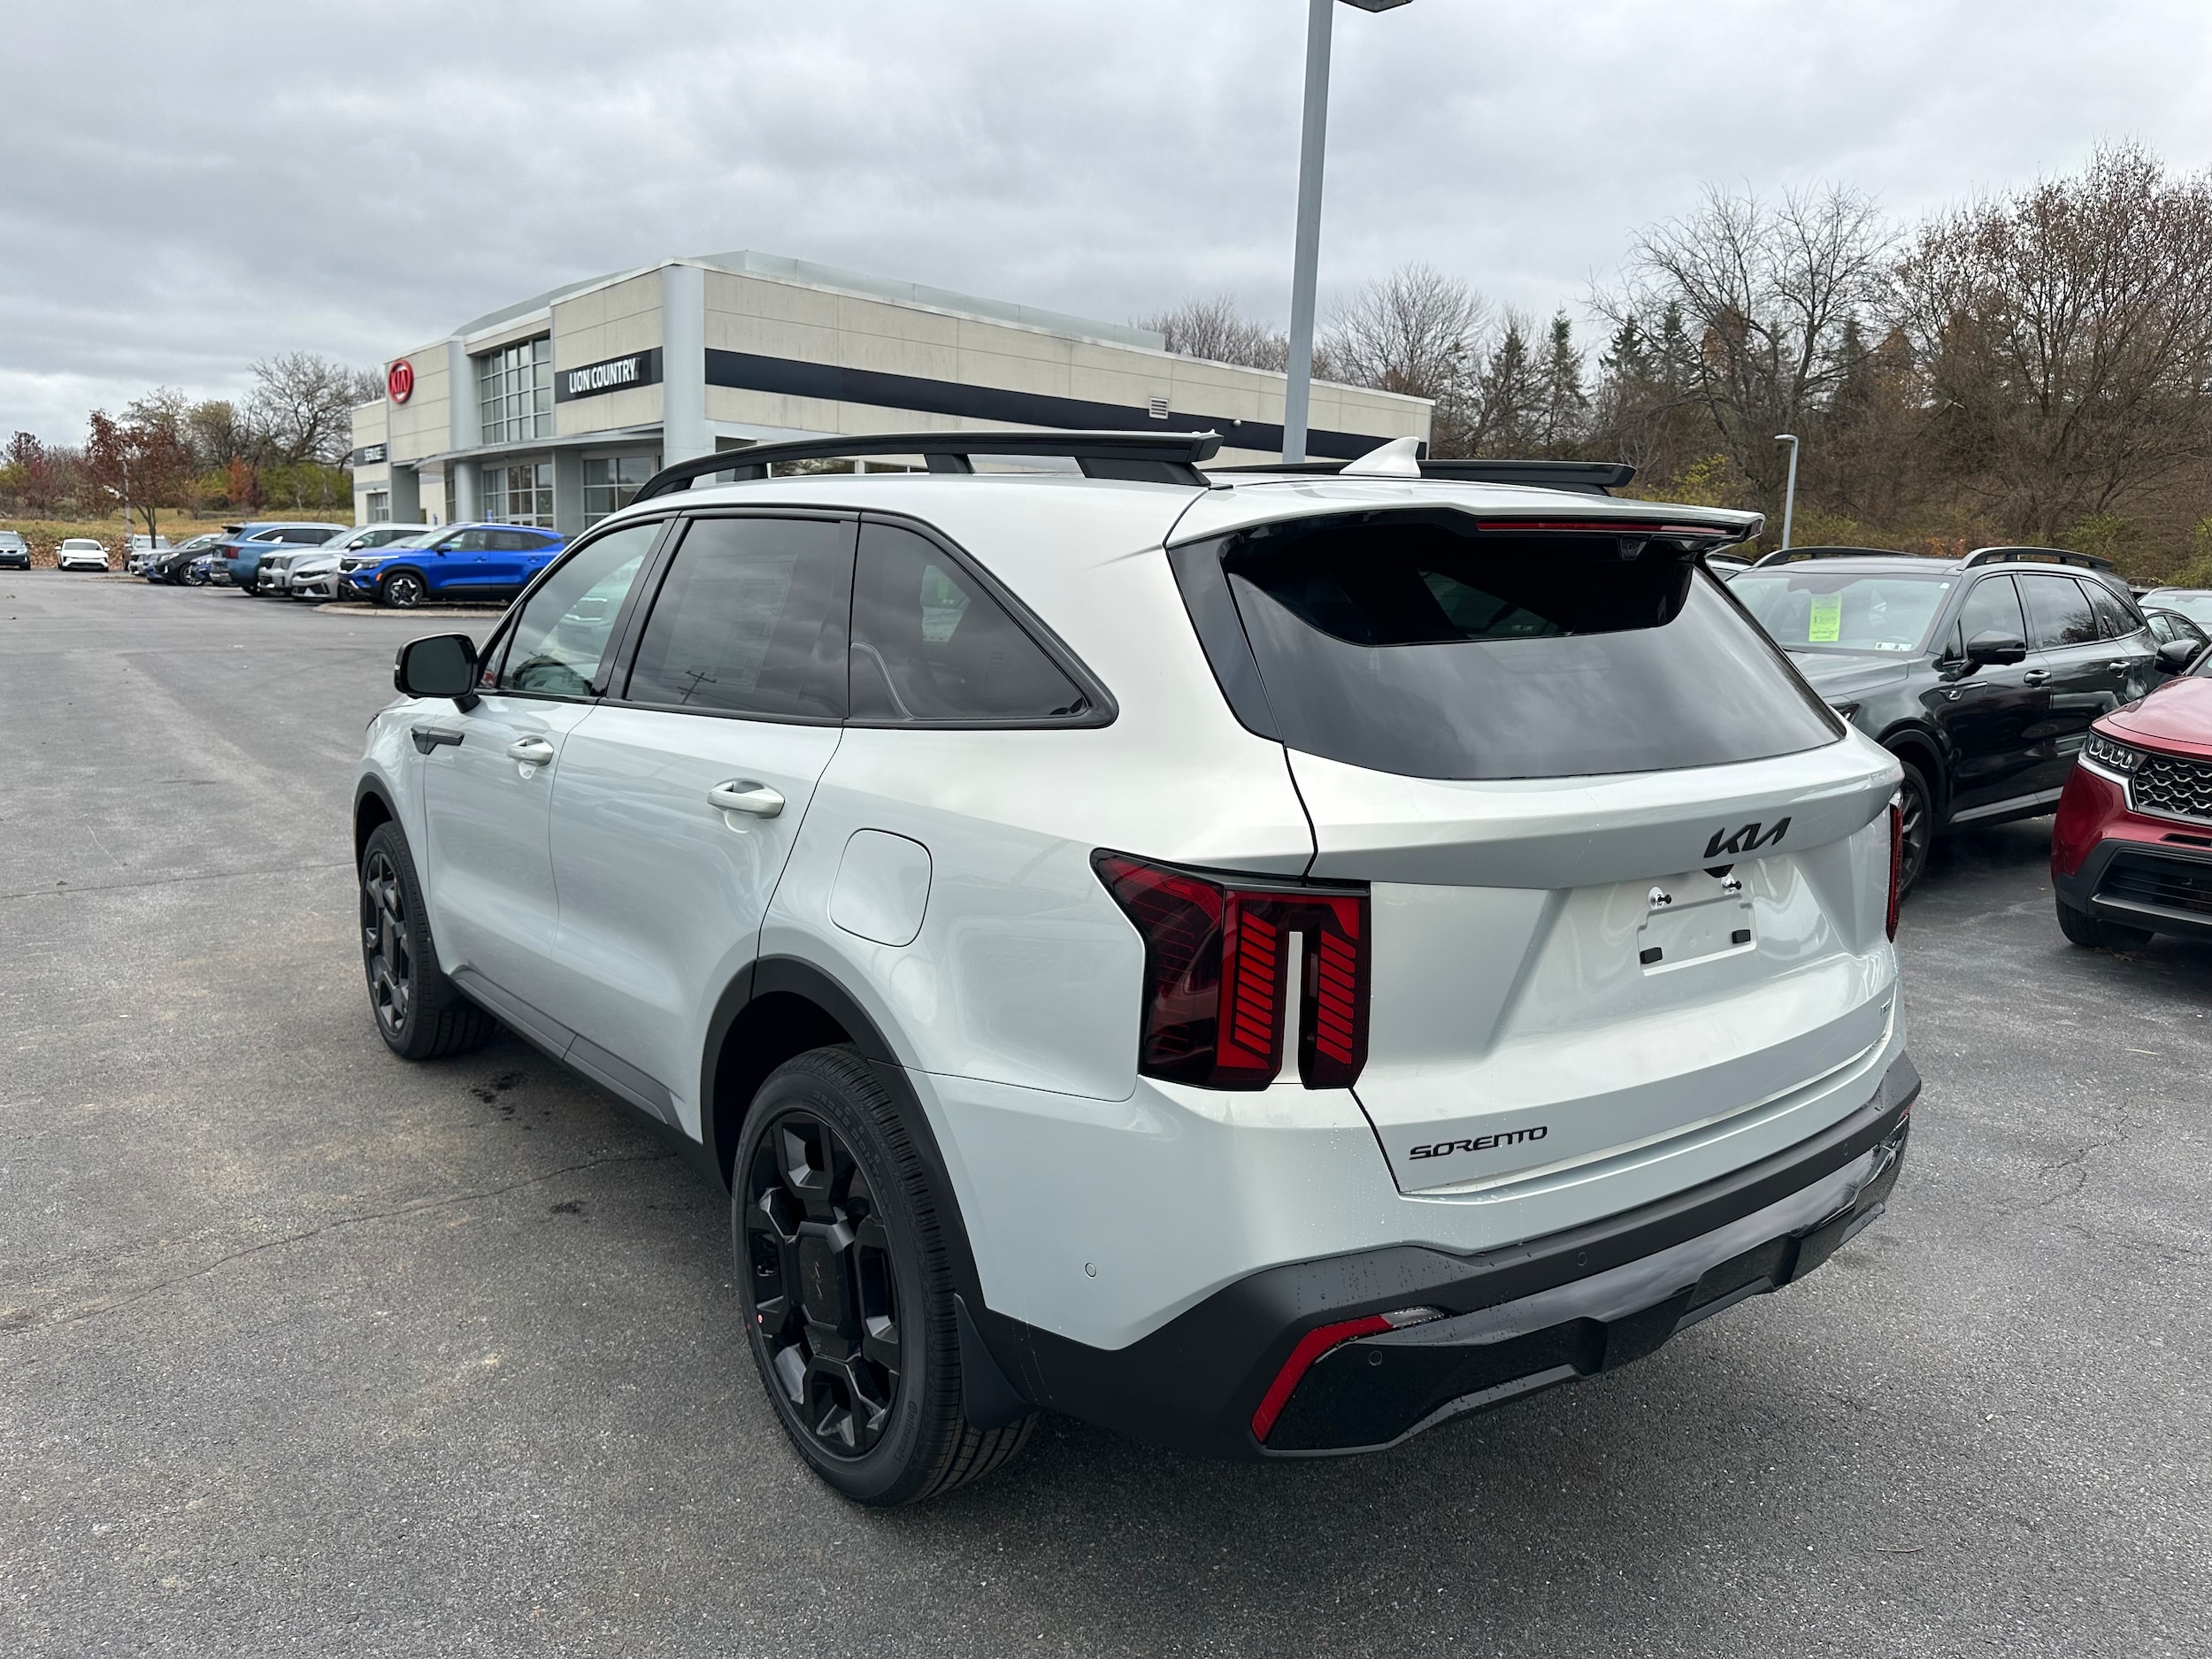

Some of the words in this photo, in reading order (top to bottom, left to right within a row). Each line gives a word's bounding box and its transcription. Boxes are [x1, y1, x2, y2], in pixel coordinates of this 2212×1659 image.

[391, 369, 409, 395] KIA
[569, 368, 590, 394] LION
[591, 357, 637, 389] COUNTRY
[1703, 817, 1792, 858] KIA
[1409, 1125, 1548, 1160] SORENTO
